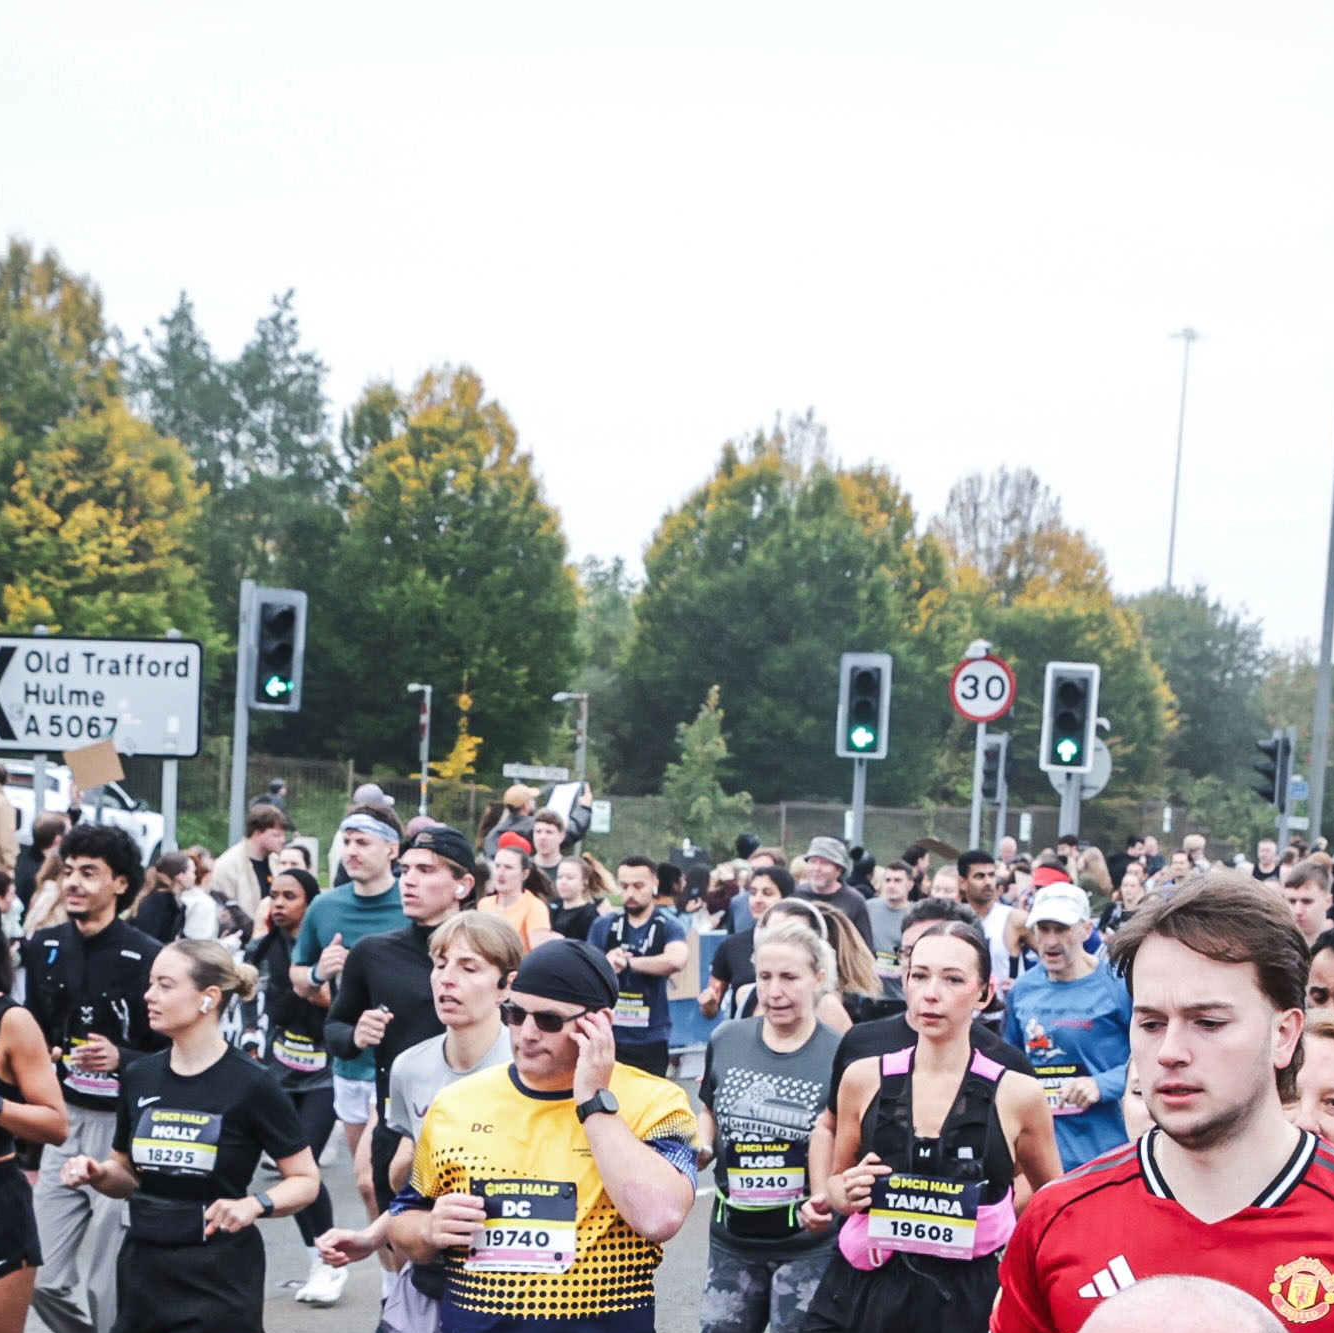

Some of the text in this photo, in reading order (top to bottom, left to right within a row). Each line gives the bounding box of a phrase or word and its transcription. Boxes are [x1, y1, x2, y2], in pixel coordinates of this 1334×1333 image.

[24, 650, 189, 677] Old Trafford
[24, 682, 105, 707] Hulme
[961, 674, 1005, 701] 30
[24, 715, 117, 738] A 5067
[471, 1122, 494, 1134] DC
[731, 1118, 787, 1139] SHEFFIELD
[147, 1148, 195, 1164] 18295
[739, 1155, 785, 1168] FLOSS
[494, 1183, 559, 1197] MCR HALF
[739, 1176, 788, 1189] 19240
[901, 1178, 964, 1195] MCR HALF
[501, 1200, 532, 1218] DC
[885, 1193, 964, 1216] TAMARA
[486, 1229, 550, 1248] 19740
[890, 1221, 953, 1243] 19608
